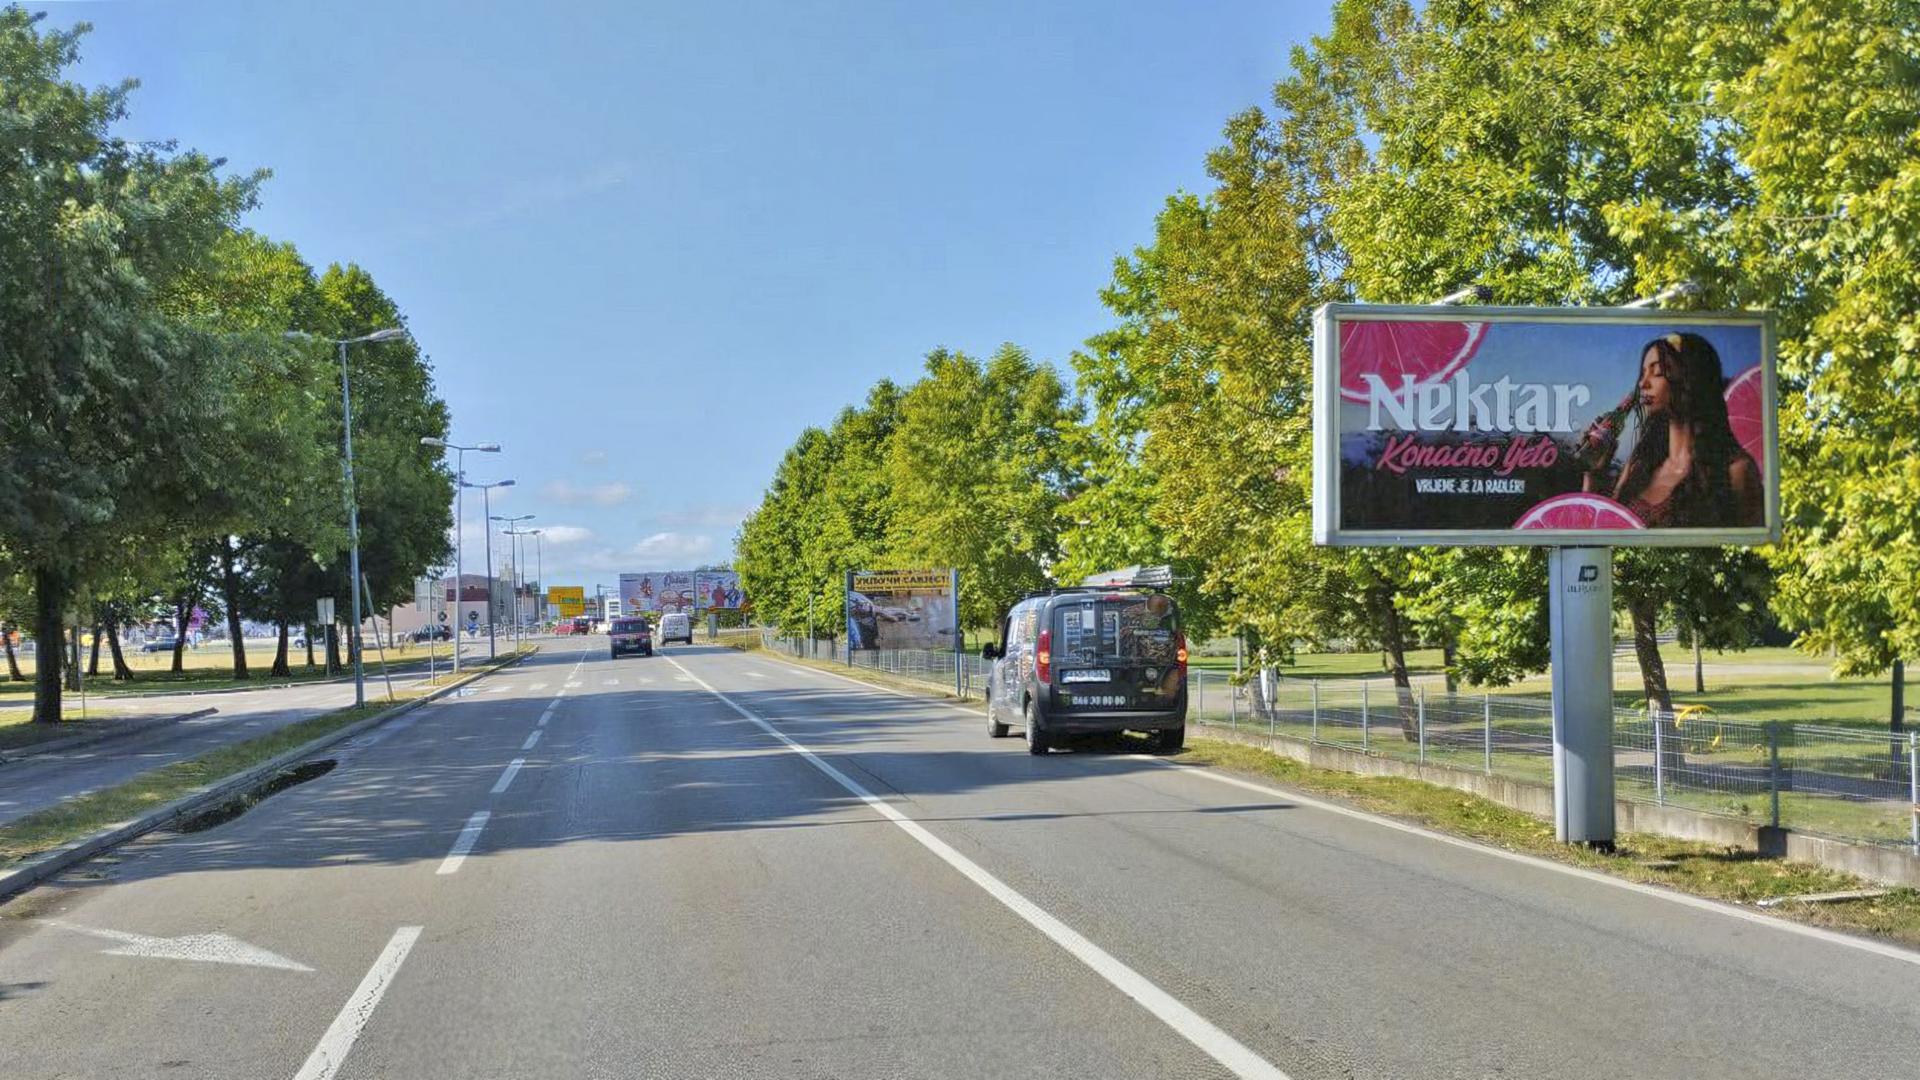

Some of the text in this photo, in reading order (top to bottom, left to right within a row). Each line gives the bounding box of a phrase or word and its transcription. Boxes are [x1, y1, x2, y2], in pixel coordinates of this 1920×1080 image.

[1360, 367, 1590, 432] Nektar
[1494, 435, 1557, 476] ljeto
[1415, 478, 1456, 493] VRIJEME
[1457, 479, 1470, 493] JE
[1471, 479, 1484, 493] ZA
